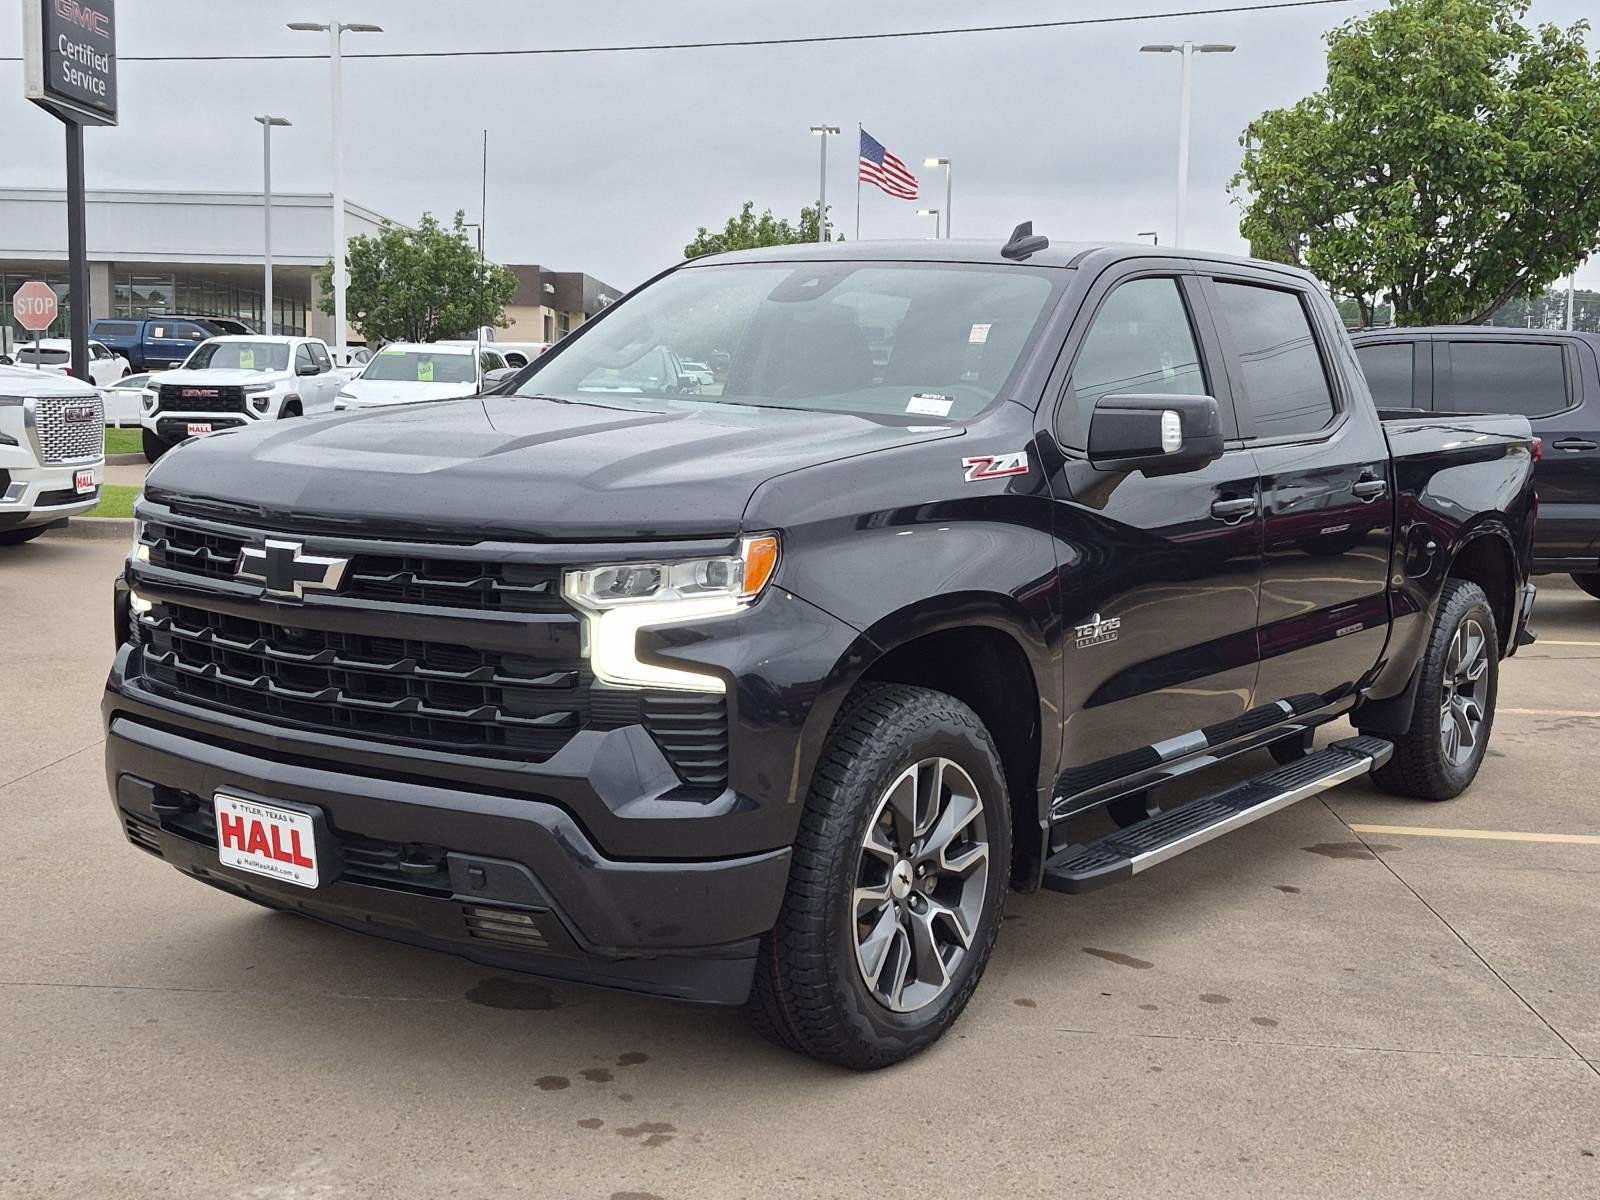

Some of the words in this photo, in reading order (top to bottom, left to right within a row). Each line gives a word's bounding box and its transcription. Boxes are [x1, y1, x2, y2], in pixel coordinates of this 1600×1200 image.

[54, 0, 110, 39] GMC
[58, 33, 109, 74] Certified
[62, 60, 106, 97] Service
[16, 297, 54, 315] STOP
[181, 389, 219, 398] GMC
[188, 425, 210, 433] HALL
[962, 451, 1029, 482] Z71
[76, 475, 95, 489] HALL
[1074, 613, 1121, 638] TEXAS
[265, 810, 288, 822] TEXAS
[220, 812, 313, 869] HALL
